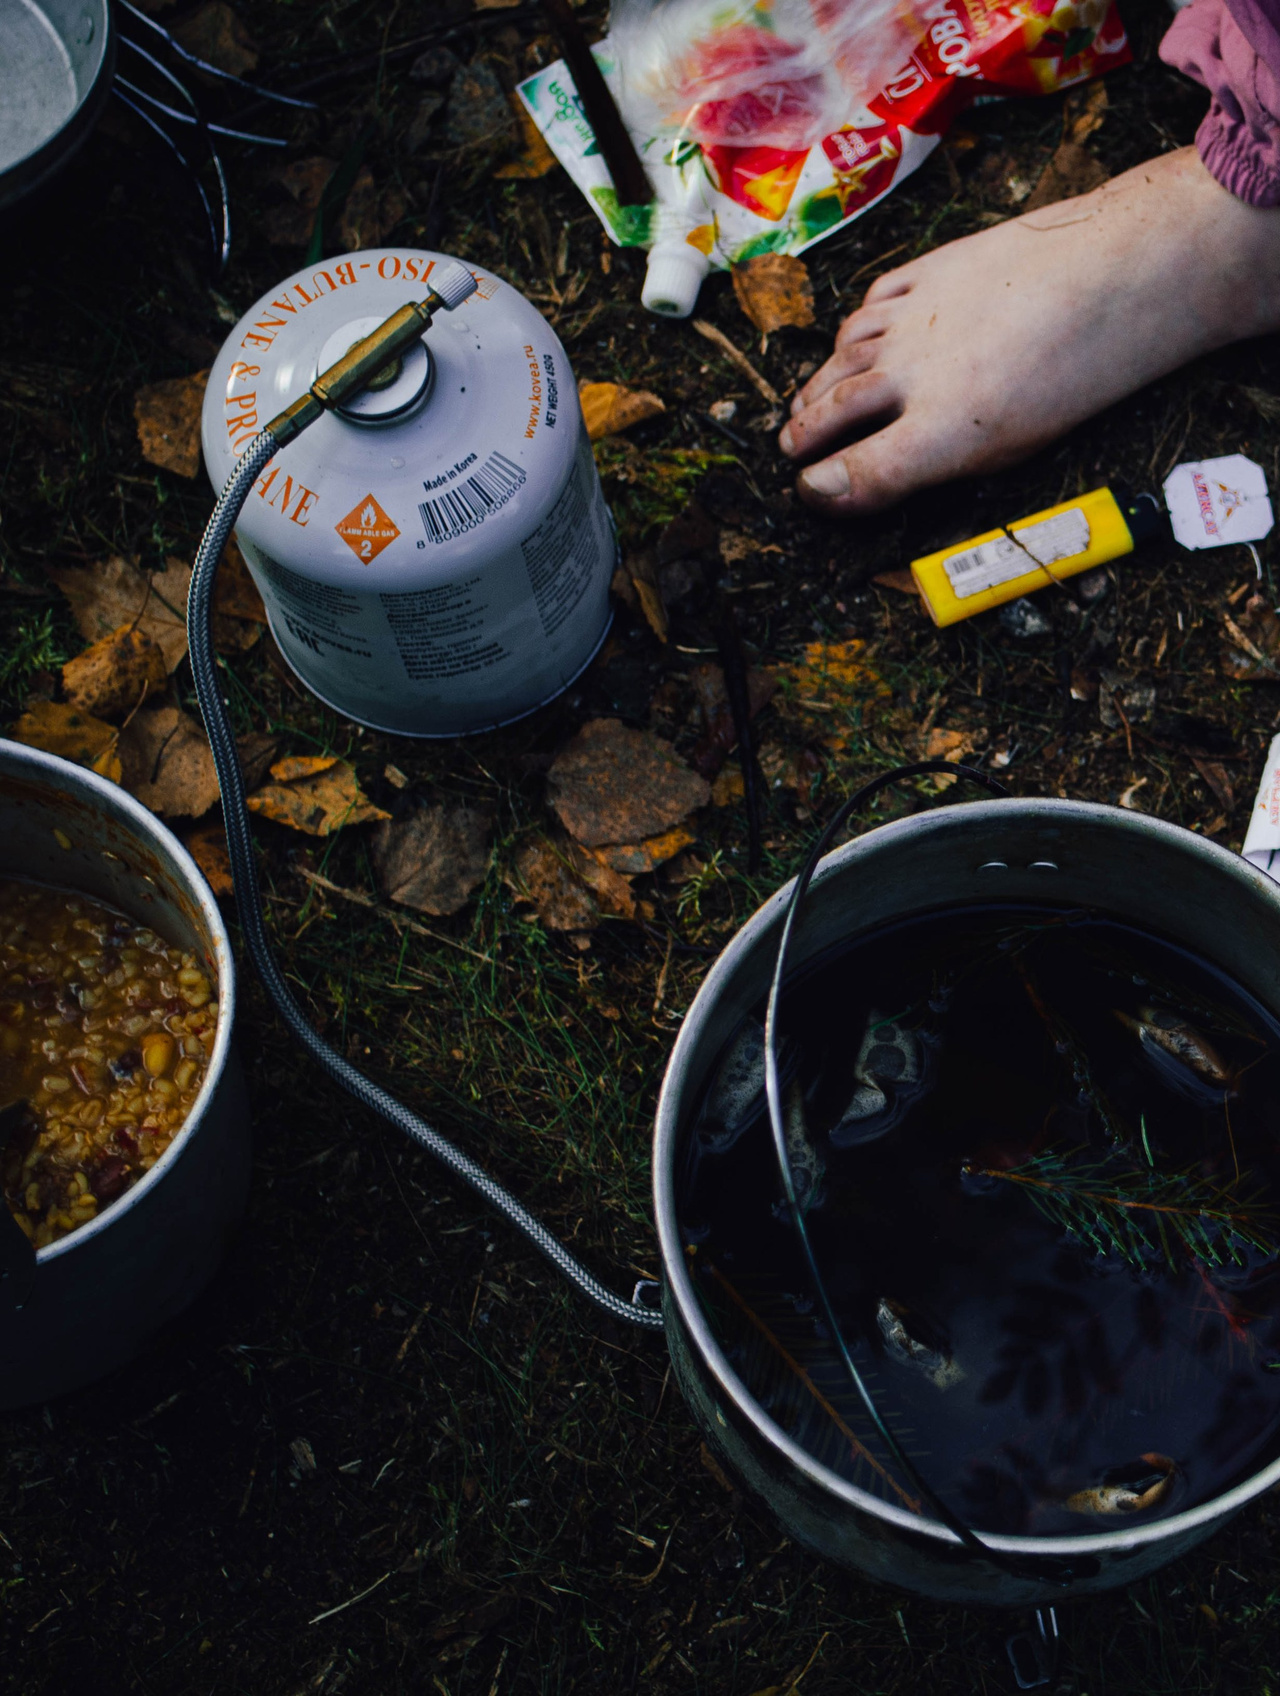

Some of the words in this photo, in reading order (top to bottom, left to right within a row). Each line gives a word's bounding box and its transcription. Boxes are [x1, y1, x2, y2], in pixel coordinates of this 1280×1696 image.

[227, 360, 261, 382] &
[522, 344, 542, 440] www.kovea.ru
[545, 377, 559, 411] WEIGHT
[545, 411, 556, 429] NET
[224, 390, 321, 528] PROANE
[423, 475, 447, 493] Made
[448, 467, 456, 481] in
[455, 452, 478, 474] Korea
[360, 539, 373, 557] 2
